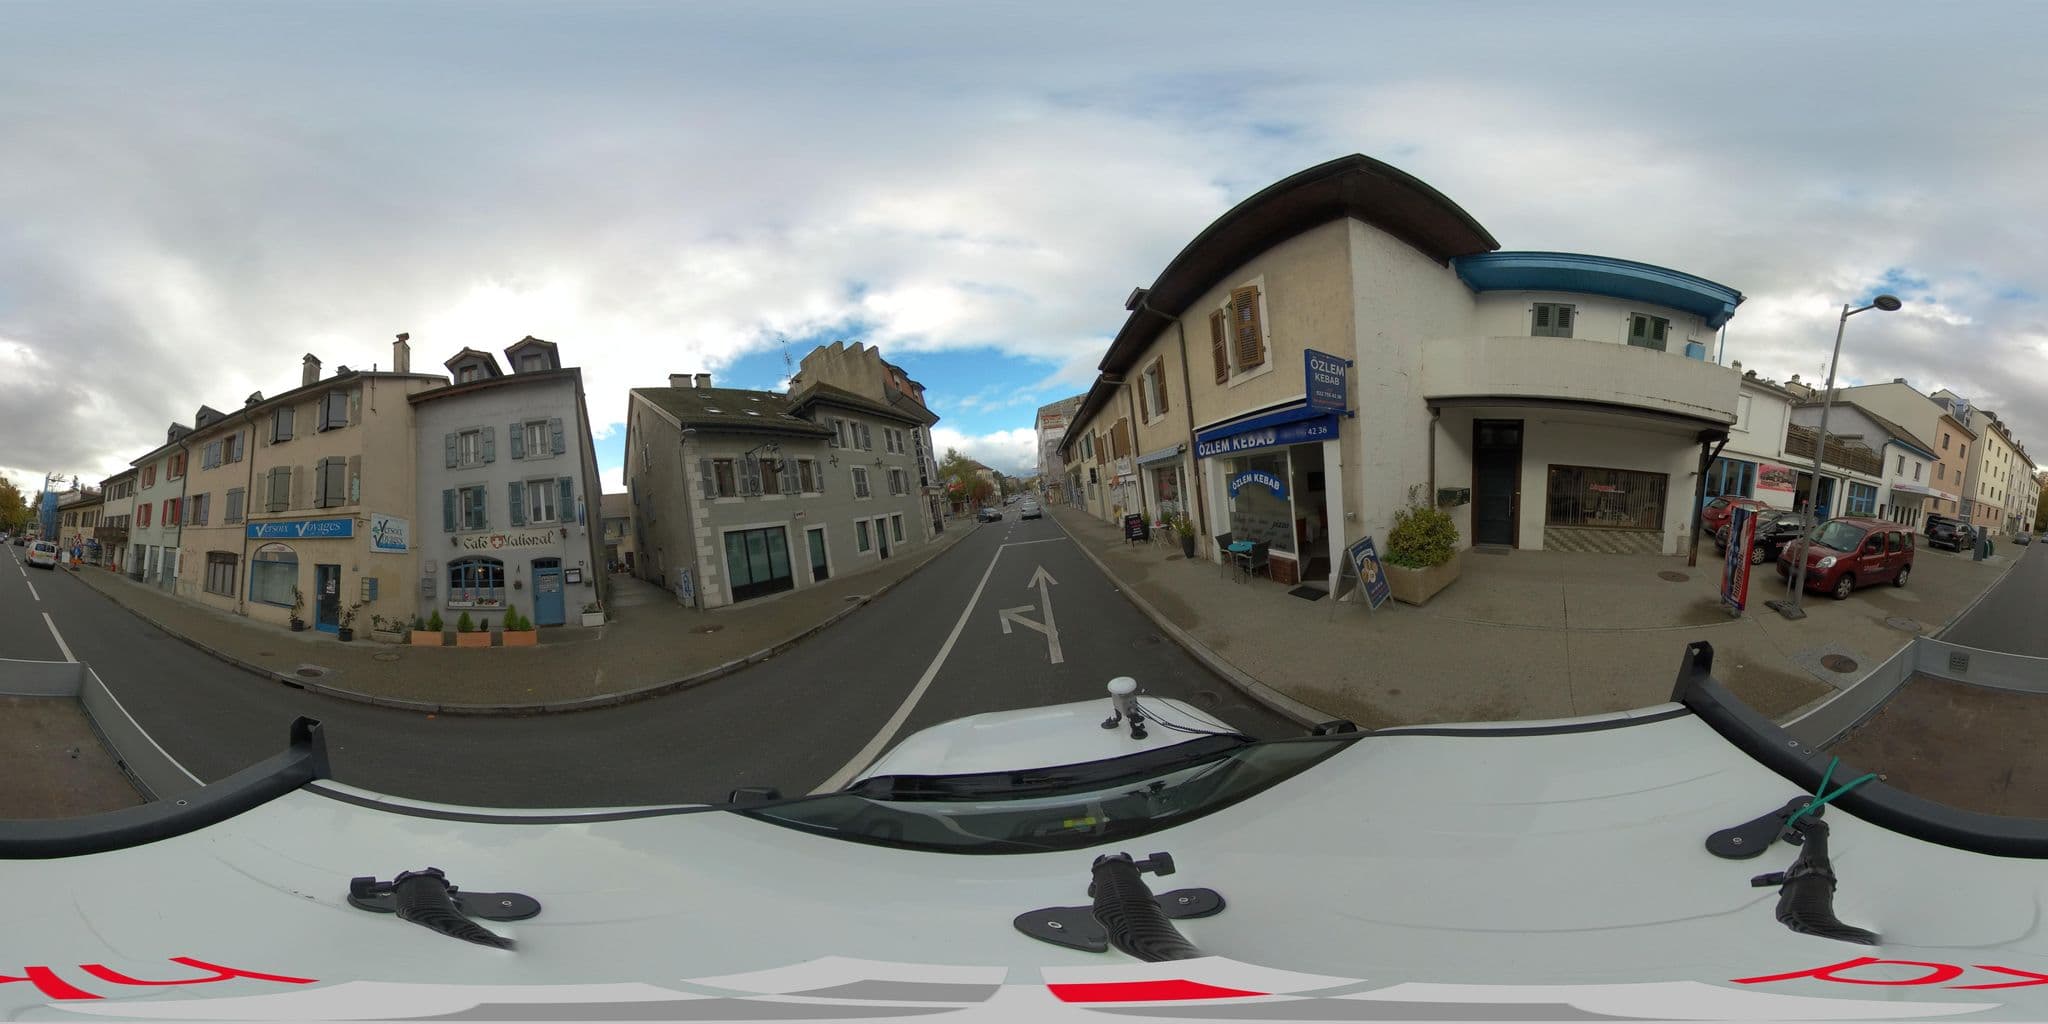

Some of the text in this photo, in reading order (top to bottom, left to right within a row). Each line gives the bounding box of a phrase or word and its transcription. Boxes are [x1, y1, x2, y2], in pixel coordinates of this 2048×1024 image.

[1311, 355, 1344, 377] ÖZLEM
[1314, 372, 1340, 386] KEBAB
[1232, 428, 1276, 450] KEBAB
[1232, 473, 1280, 490] ÖZLEM KEBAB
[463, 529, 554, 550] Café National
